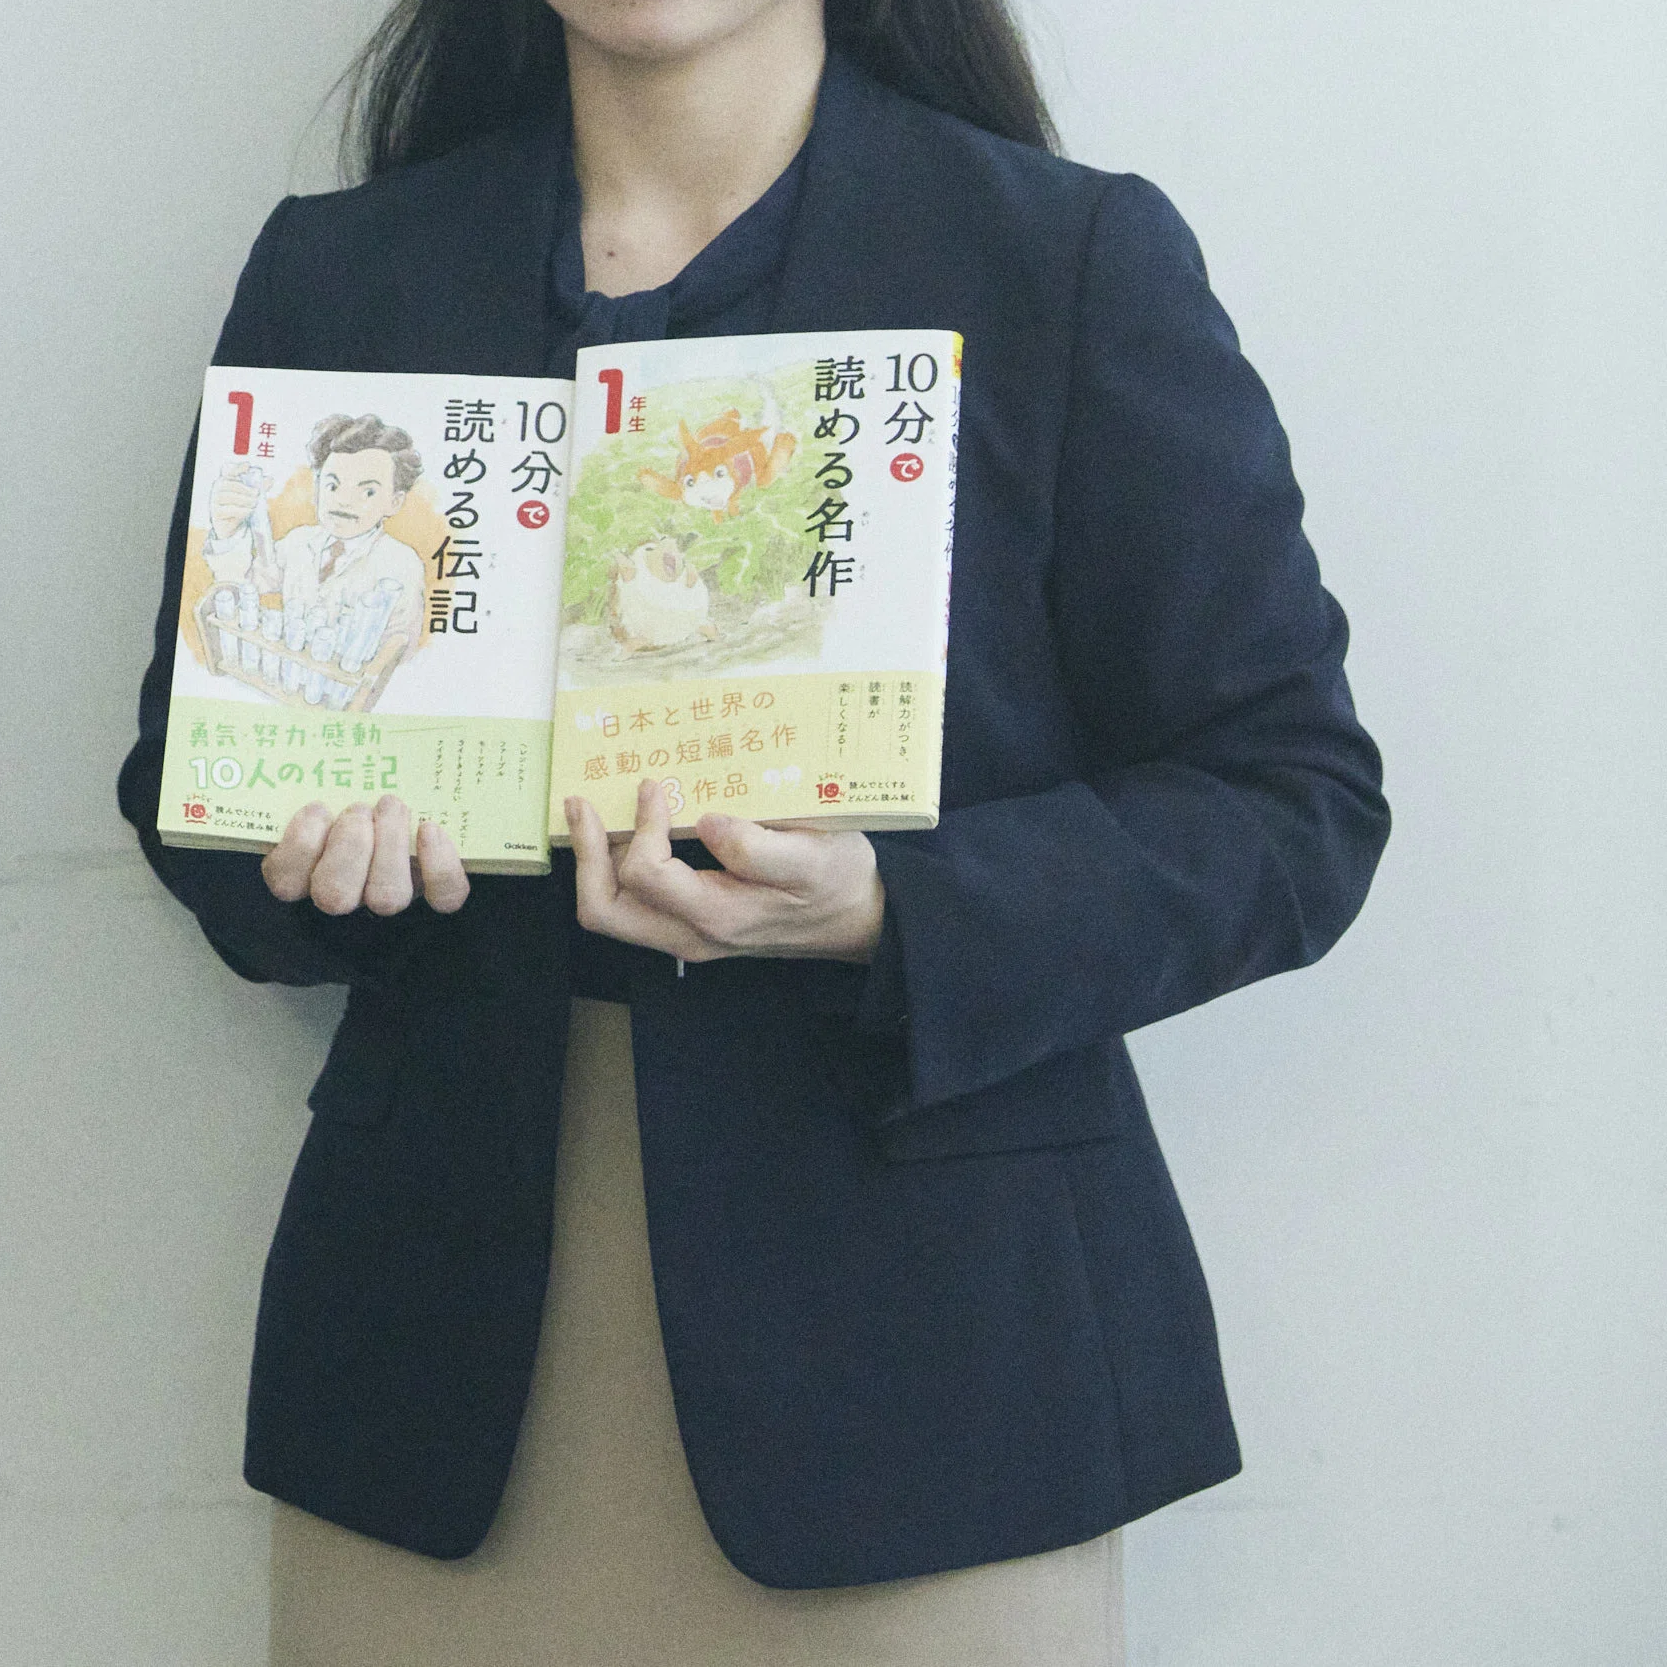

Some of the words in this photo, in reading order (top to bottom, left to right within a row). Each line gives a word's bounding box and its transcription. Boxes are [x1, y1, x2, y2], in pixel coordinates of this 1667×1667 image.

[884, 353, 939, 479] 10分で
[511, 401, 567, 526] 10分で
[802, 355, 866, 598] 読める名作
[429, 399, 496, 634] 読める伝記
[583, 723, 798, 782] 感動の短編名作
[601, 690, 776, 739] 日本と世界の
[188, 755, 398, 791] 10人の伝記
[504, 842, 538, 851] Gakken
